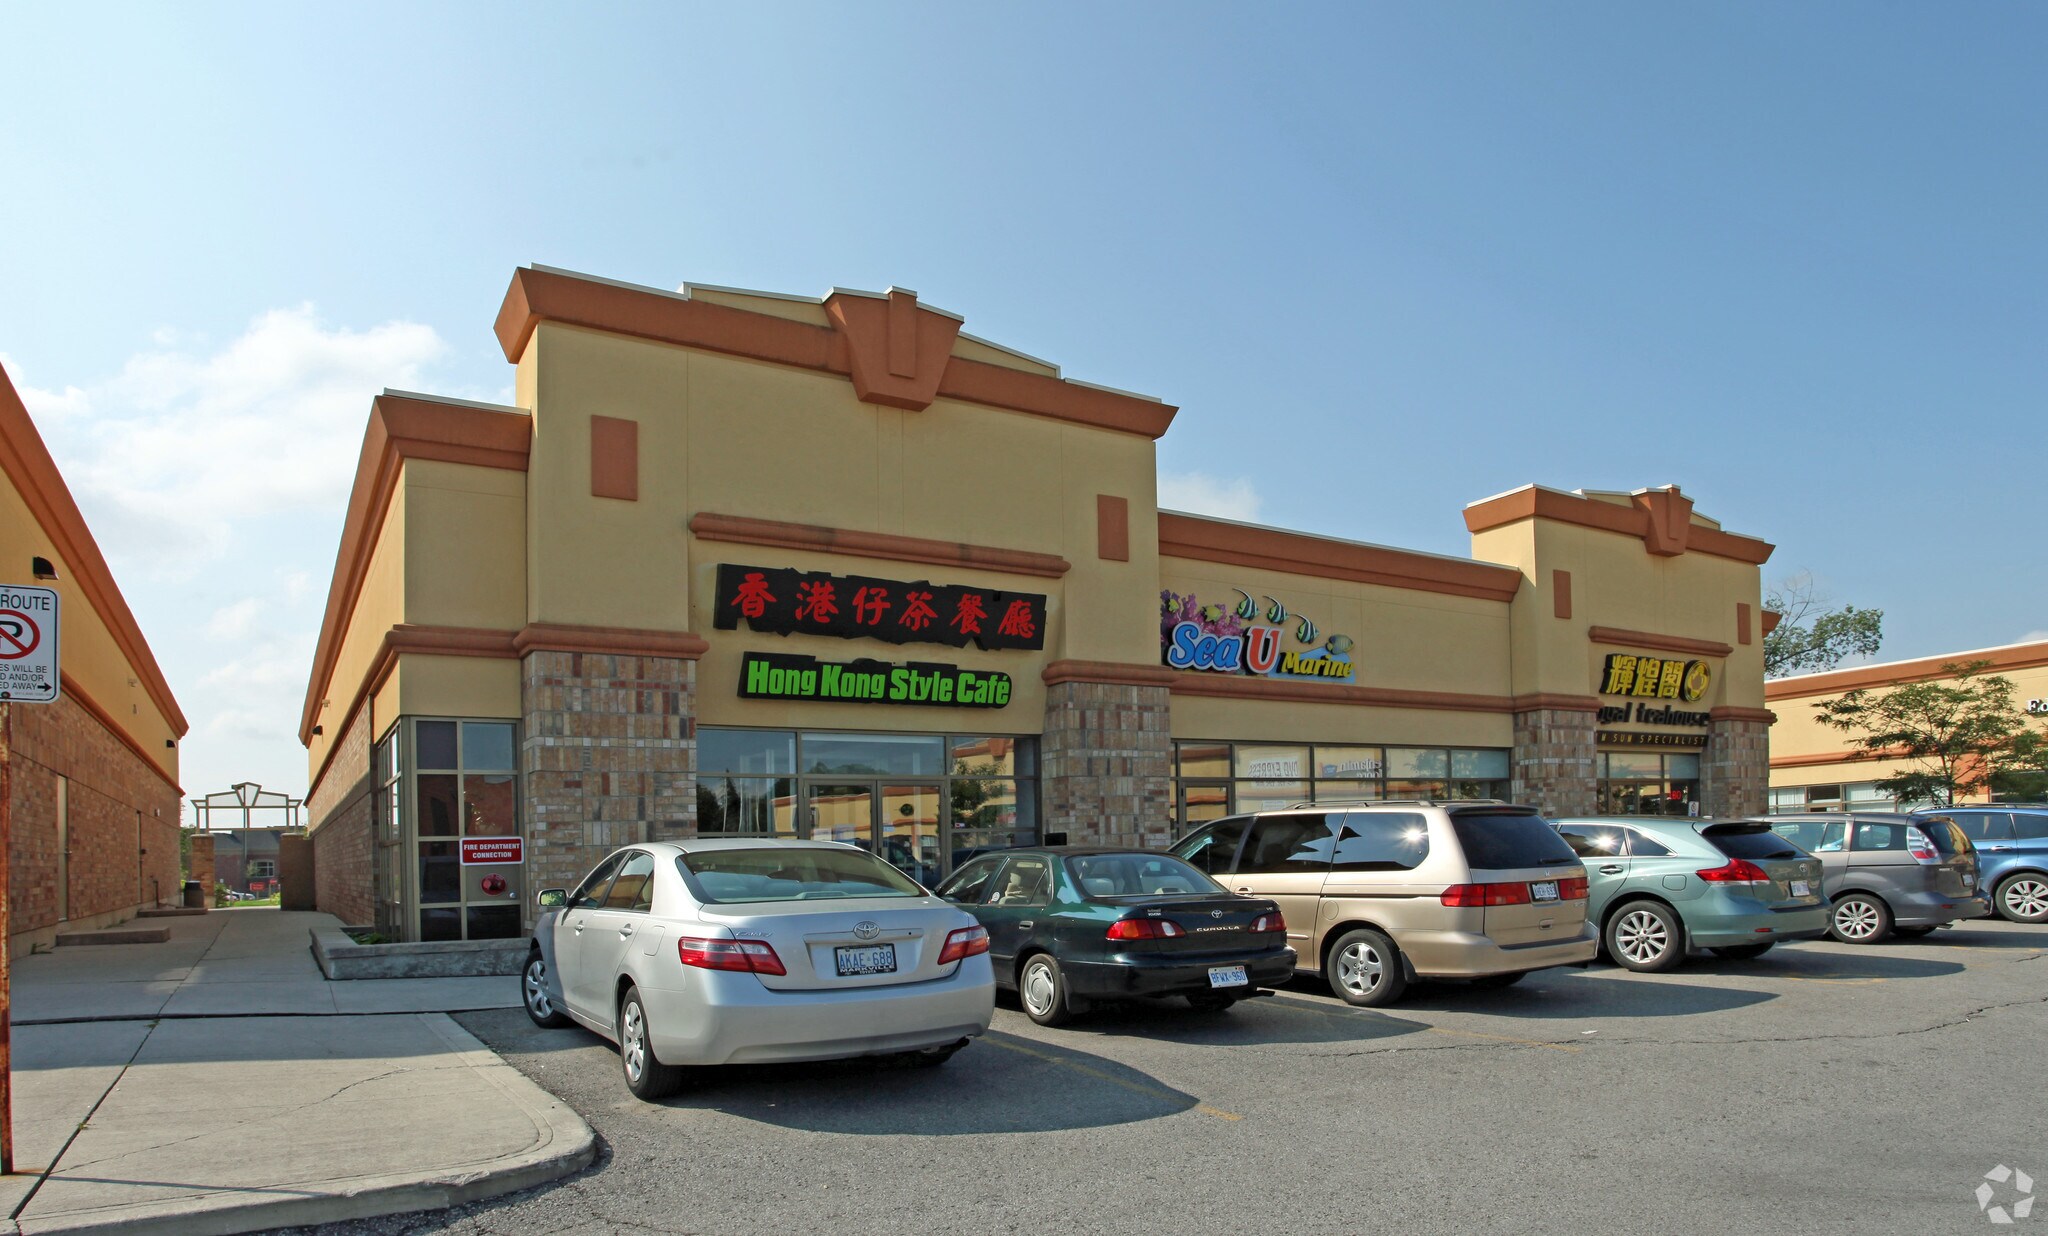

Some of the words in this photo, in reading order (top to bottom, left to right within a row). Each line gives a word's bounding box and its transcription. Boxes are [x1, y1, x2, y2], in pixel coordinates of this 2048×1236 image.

[1, 594, 50, 611] ROUTE
[731, 572, 1036, 639] 香港仔茶餐廳
[1169, 621, 1240, 670] Sea
[1246, 627, 1281, 673] U
[1281, 652, 1355, 678] Marine
[9, 673, 44, 682] AND/OR
[12, 664, 33, 672] WILL
[35, 665, 48, 674] BE
[1605, 654, 1685, 699] 輝煌閣
[12, 682, 37, 690] AWAY
[746, 659, 817, 697] Hong
[820, 664, 886, 699] Kong
[889, 668, 953, 702] Style
[956, 672, 1012, 705] Café
[1640, 734, 1705, 745] SPECIALIST
